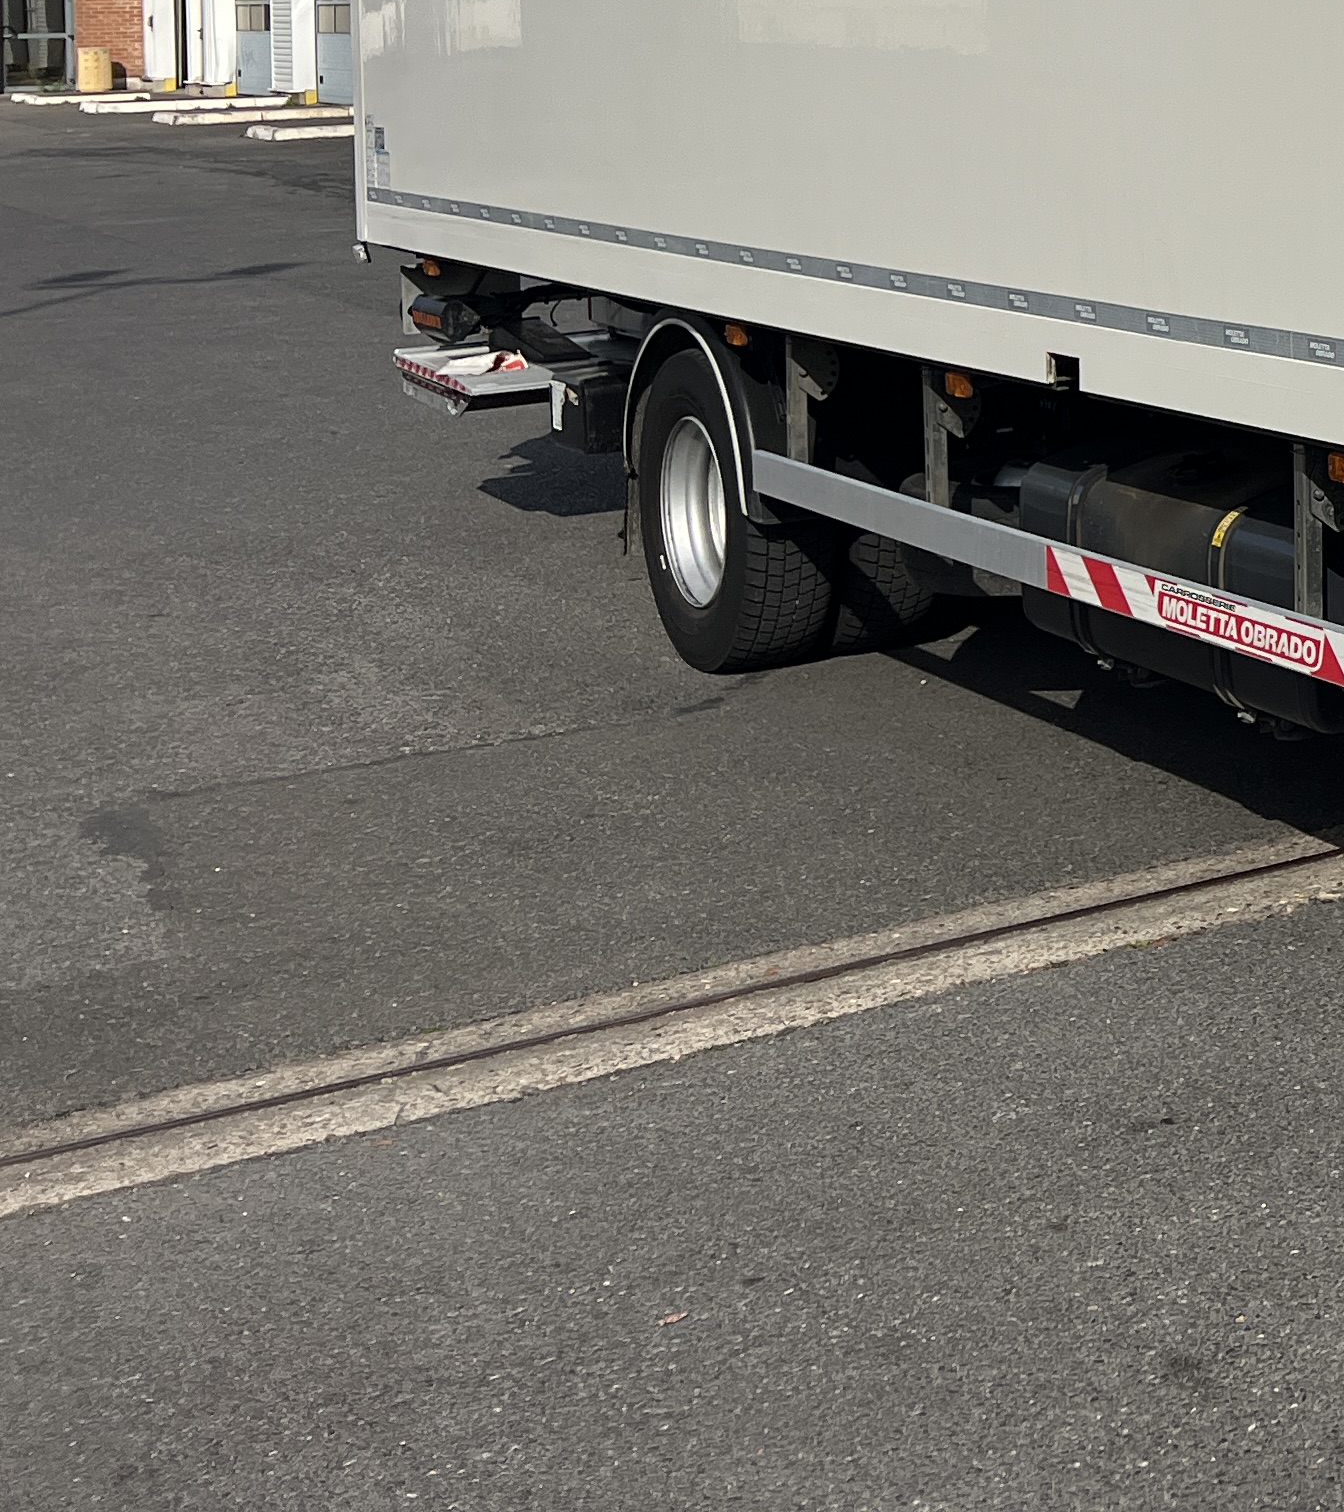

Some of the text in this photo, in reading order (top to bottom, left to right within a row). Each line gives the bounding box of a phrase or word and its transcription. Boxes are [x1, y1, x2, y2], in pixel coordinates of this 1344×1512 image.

[1161, 583, 1236, 612] CARROSSERIE
[1161, 595, 1316, 665] MOLETTA OBRADO
